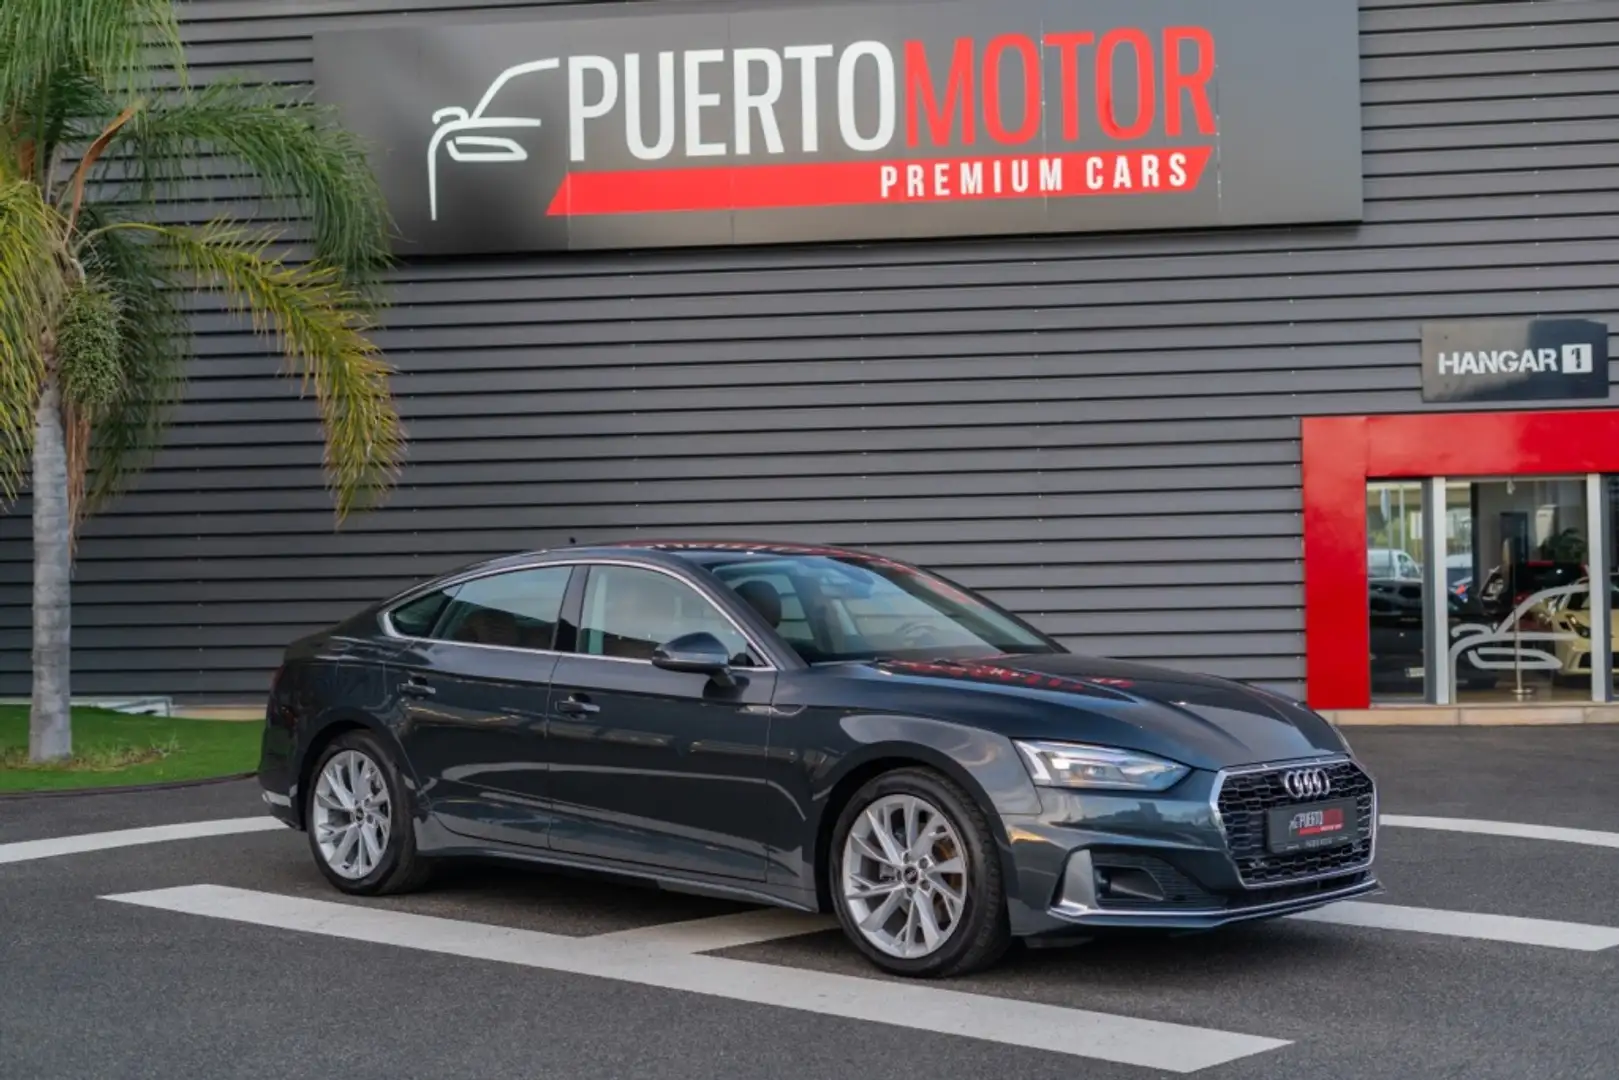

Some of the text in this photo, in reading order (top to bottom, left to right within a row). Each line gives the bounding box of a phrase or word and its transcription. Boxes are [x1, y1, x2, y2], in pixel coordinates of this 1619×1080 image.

[880, 152, 1187, 198] PREMIUM CARS
[1438, 349, 1558, 375] HANGAR
